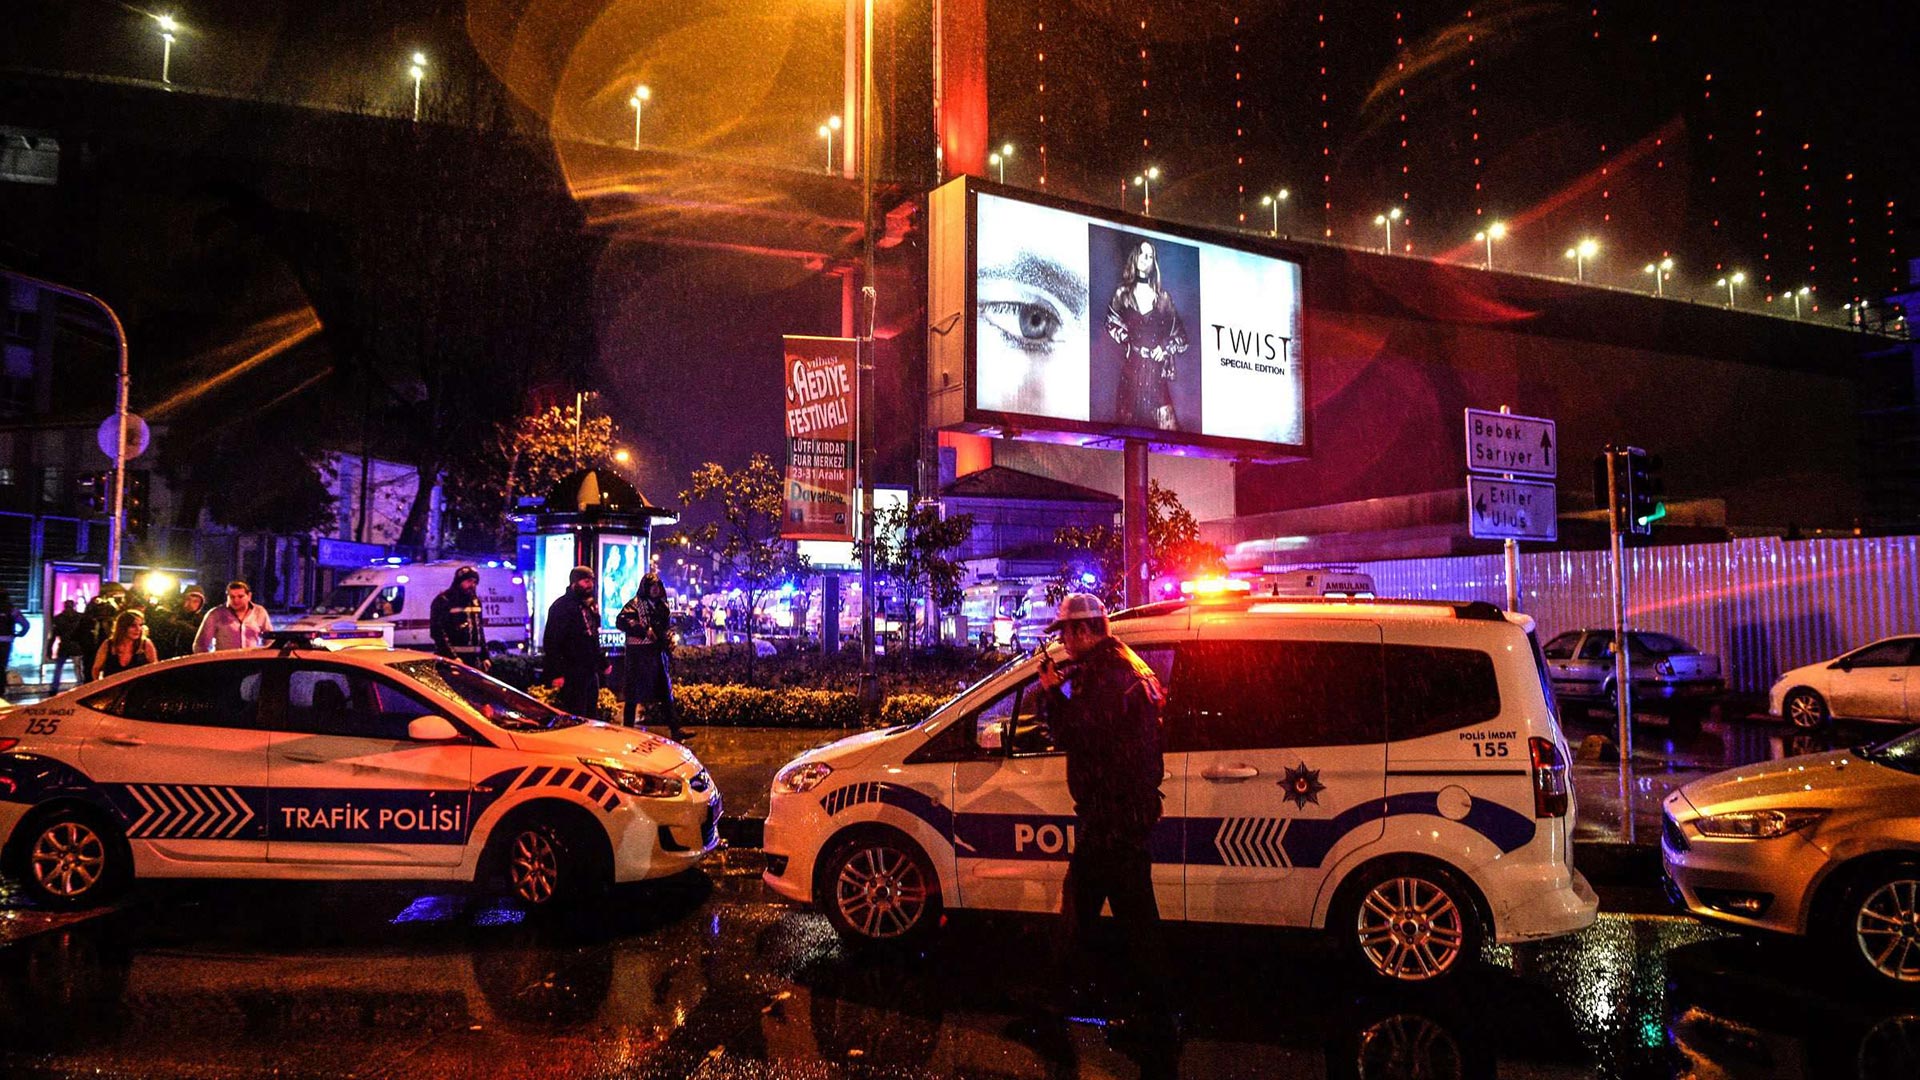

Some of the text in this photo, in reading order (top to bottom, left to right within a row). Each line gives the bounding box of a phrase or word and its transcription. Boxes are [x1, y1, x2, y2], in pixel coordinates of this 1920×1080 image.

[1211, 323, 1292, 363] TWIST
[1220, 358, 1285, 376] SPECIAL EDITION
[1475, 419, 1521, 440] Bebek
[793, 438, 845, 455] LÜTFİ KIRDAR
[1476, 443, 1532, 466] Sarıyer
[793, 454, 812, 467] FUAR
[792, 467, 845, 481] 23-31 Aralık
[1490, 487, 1532, 505] Etiler
[1491, 510, 1526, 528] Ulus
[485, 605, 500, 616] 112
[24, 719, 61, 735] 155
[1459, 730, 1517, 741] POLİS İMDAT
[1473, 742, 1508, 757] 155
[281, 803, 461, 832] TRAFİK POLİSİ
